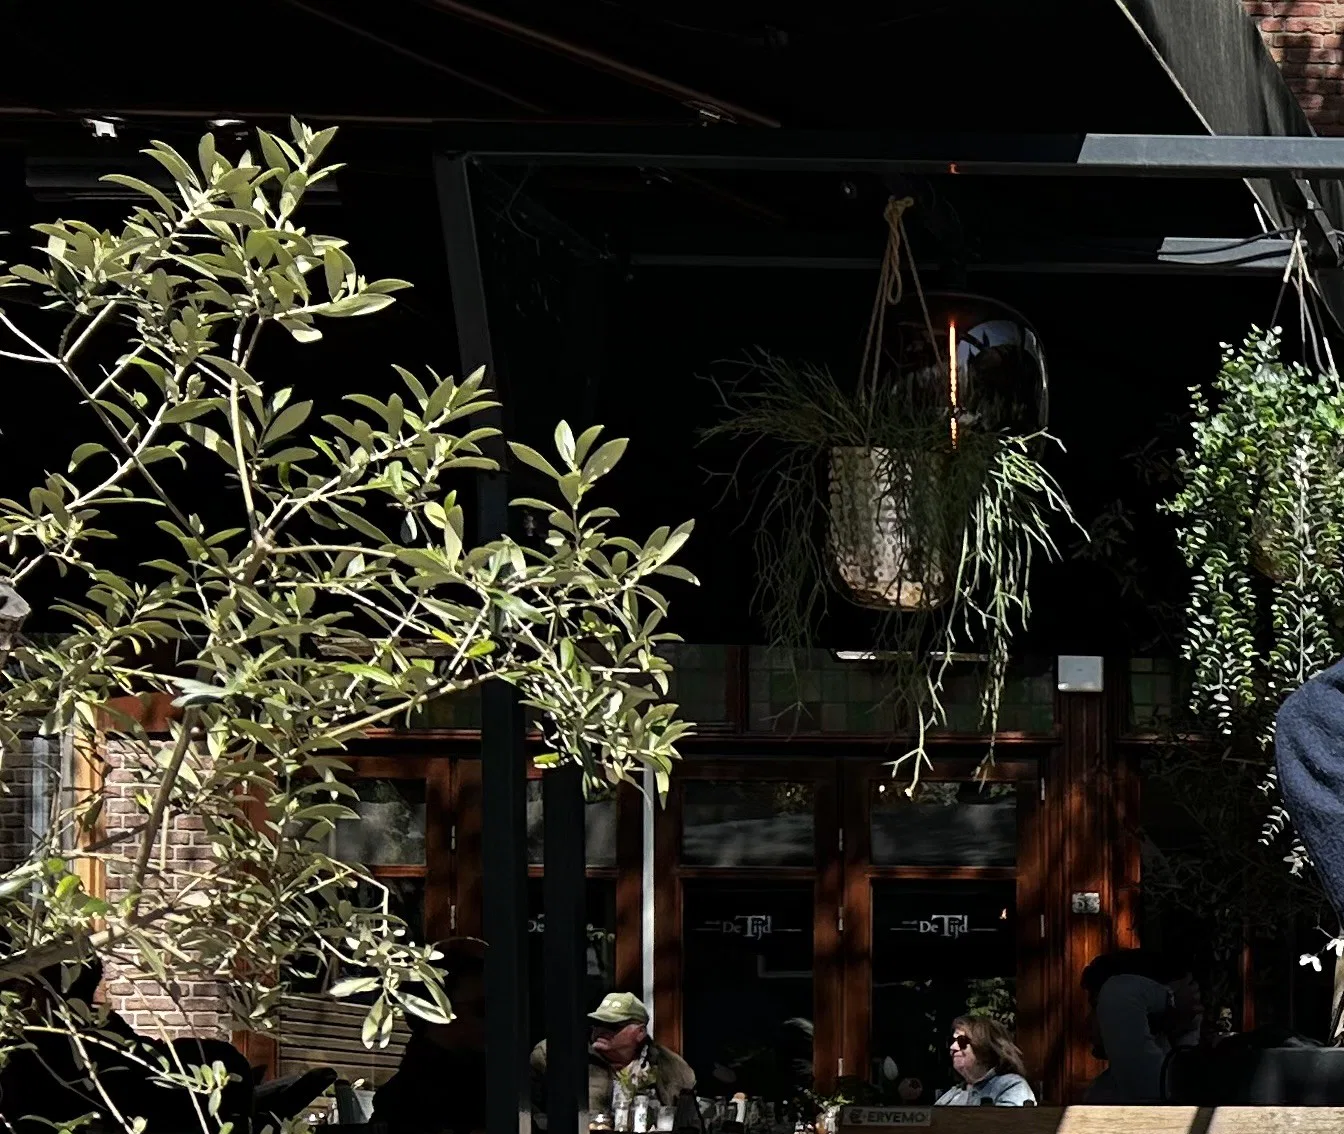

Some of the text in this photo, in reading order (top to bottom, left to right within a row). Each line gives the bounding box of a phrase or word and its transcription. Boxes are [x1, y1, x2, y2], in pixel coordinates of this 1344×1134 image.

[722, 914, 772, 940] De Tijd
[919, 914, 968, 940] De Tijd
